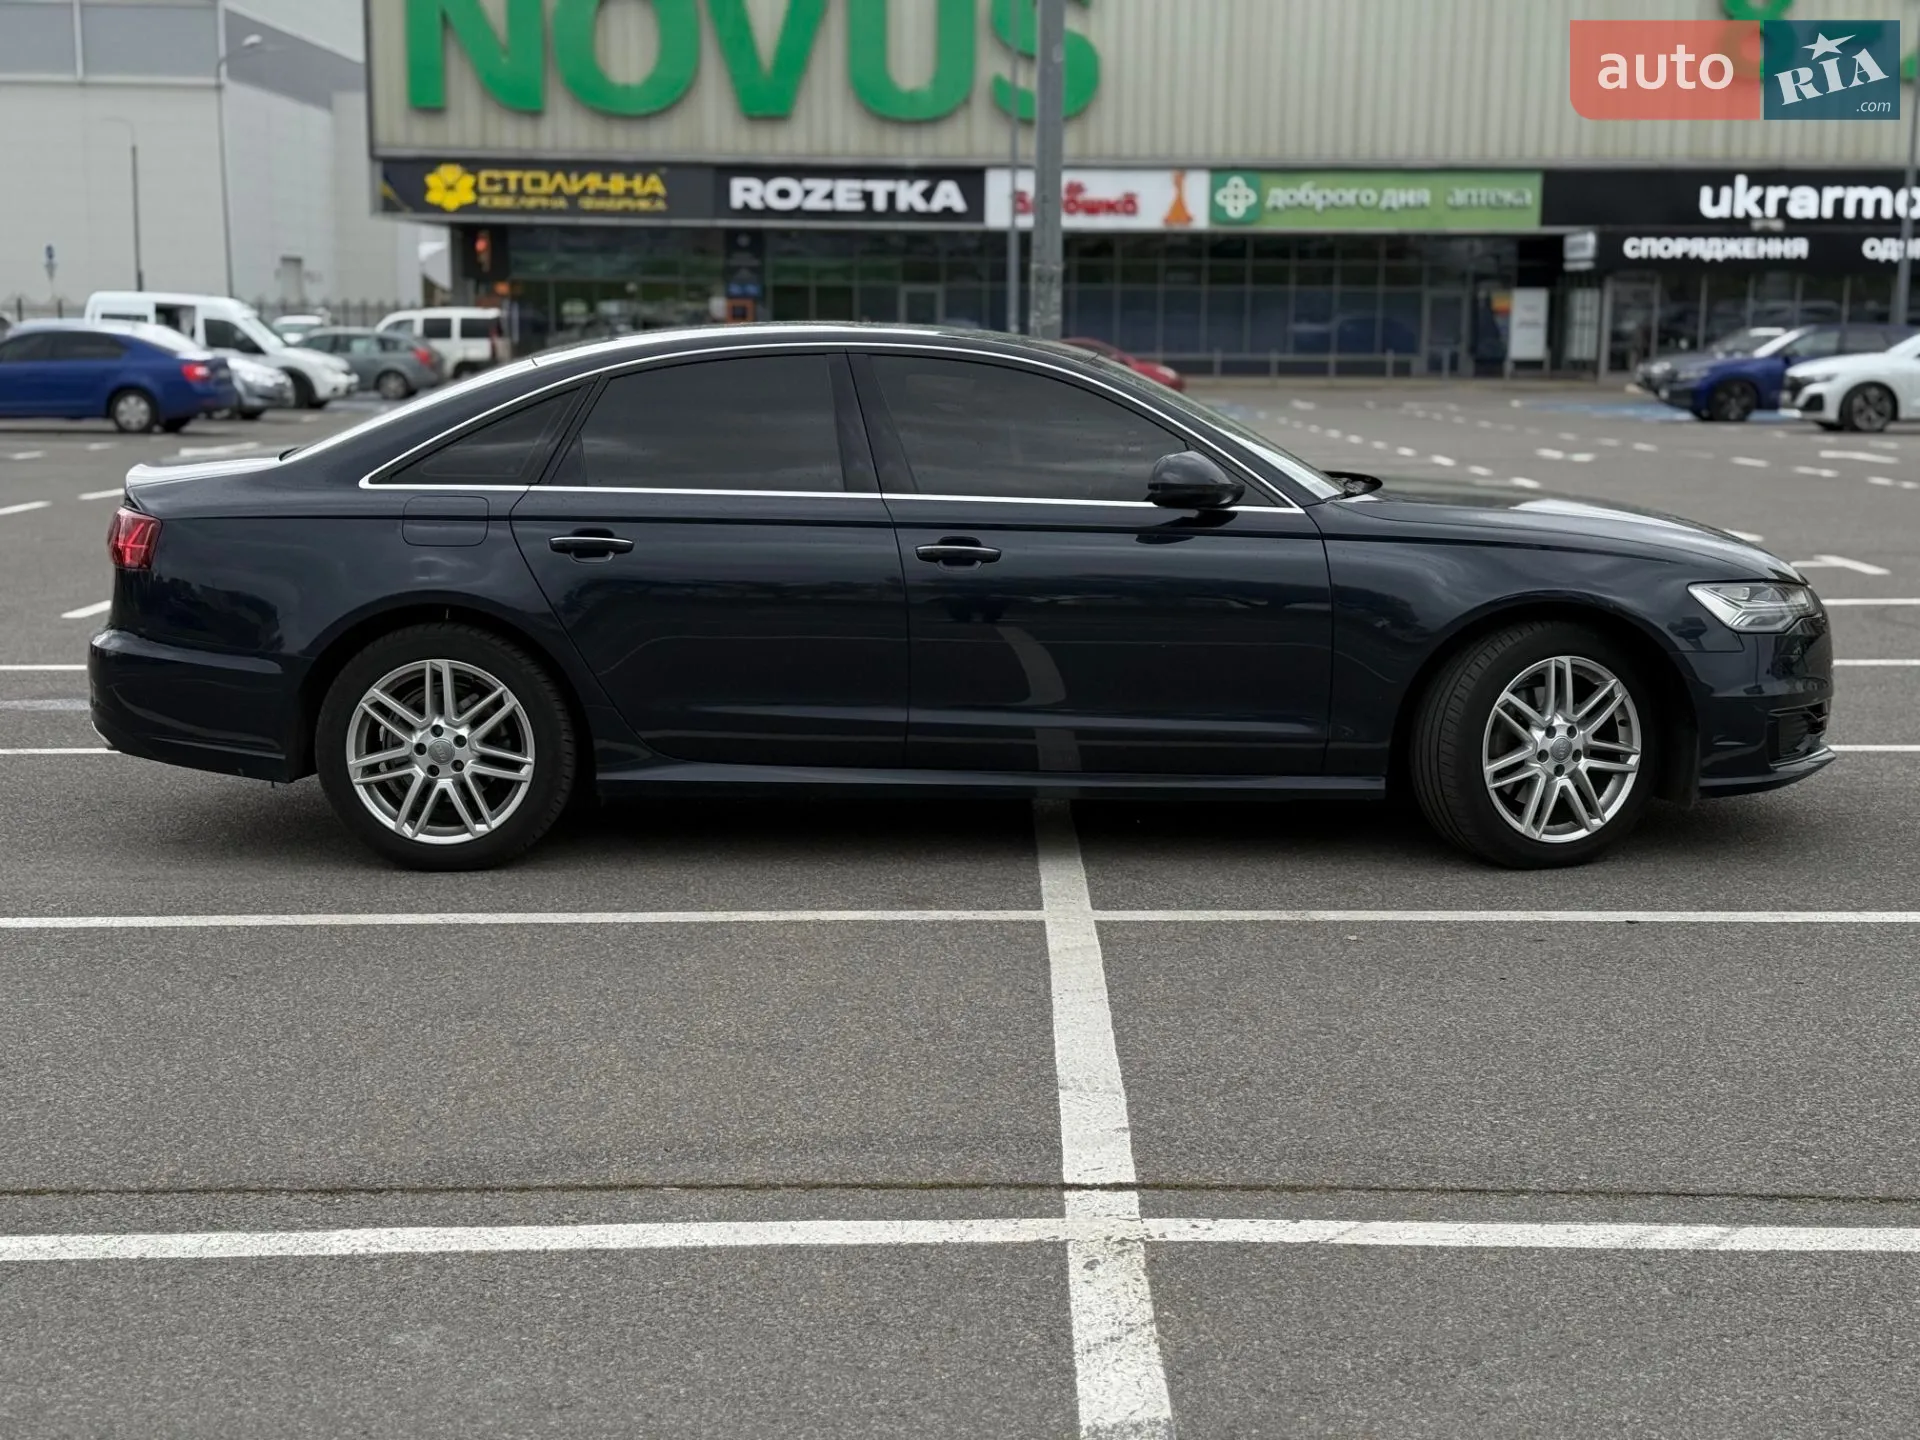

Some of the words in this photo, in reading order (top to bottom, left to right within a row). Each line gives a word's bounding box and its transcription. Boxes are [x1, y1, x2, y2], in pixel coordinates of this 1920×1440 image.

[406, 0, 1101, 120] NOVUS
[476, 169, 667, 196] СТОЛИЧНА
[728, 176, 968, 213] ROZETKA
[1265, 180, 1379, 213] доброго
[1378, 187, 1432, 211] дня
[1446, 186, 1533, 209] аптека
[1622, 236, 1809, 262] СПОРЯДЖЕННЯ
